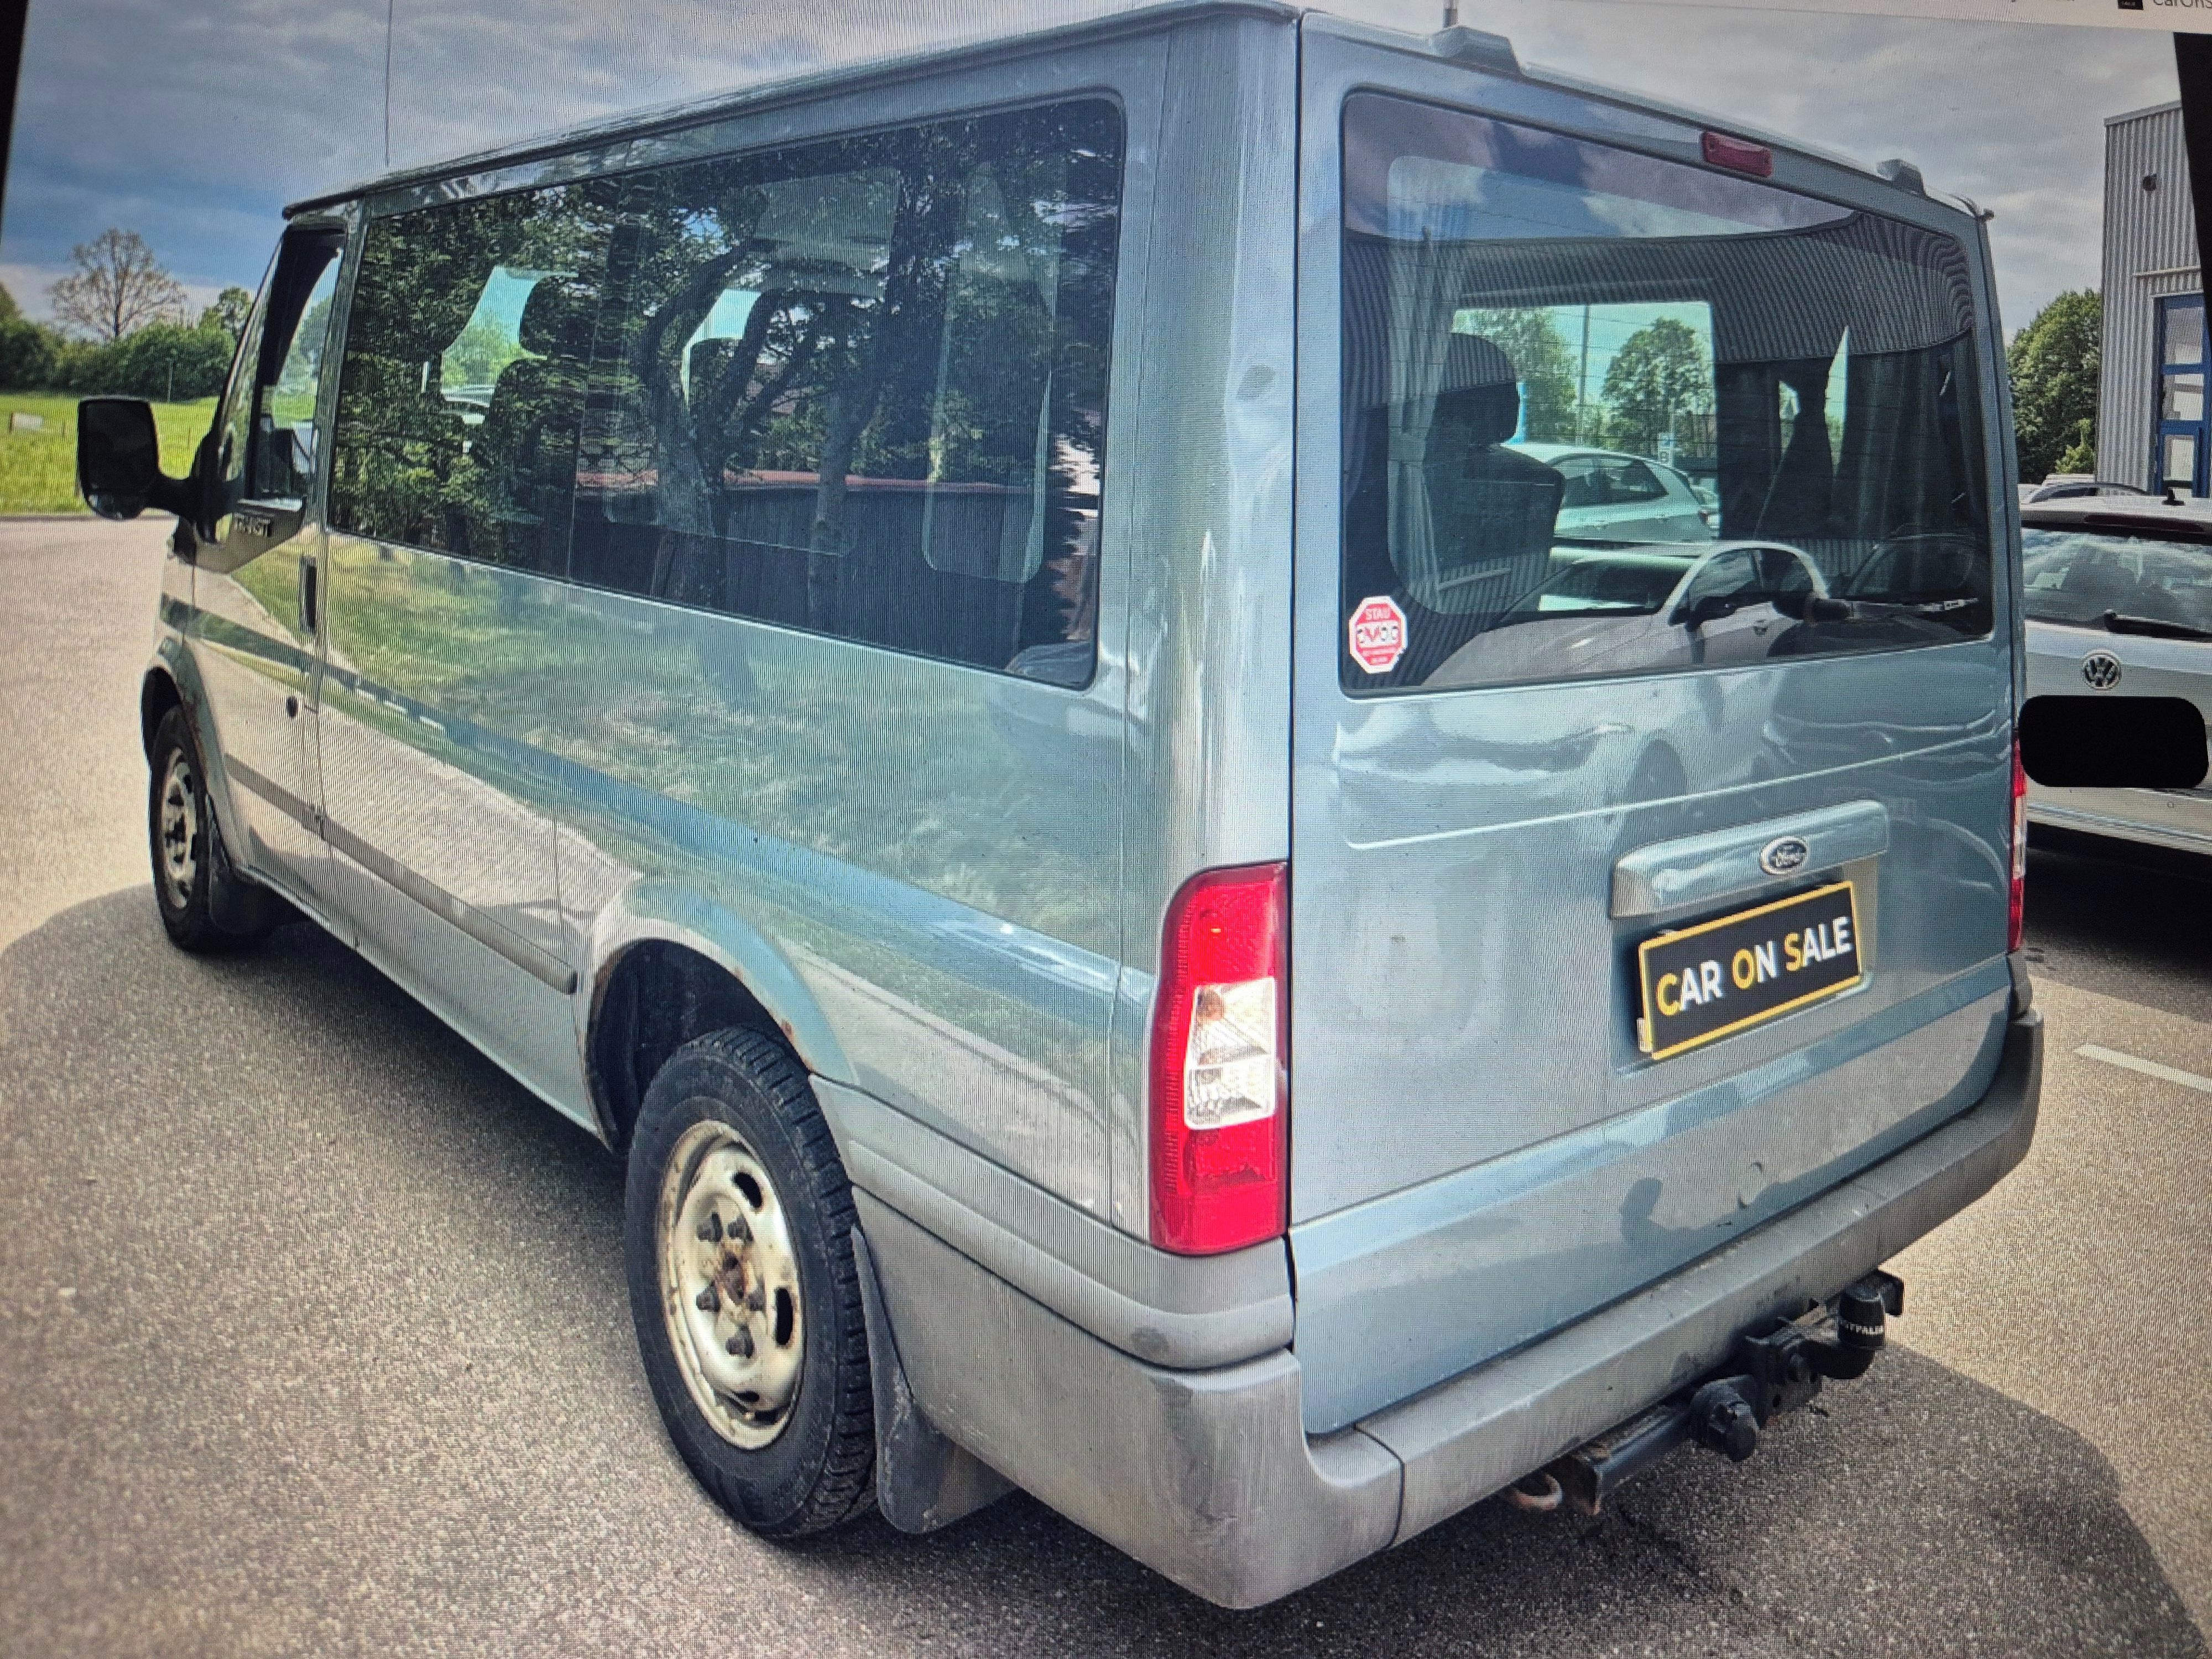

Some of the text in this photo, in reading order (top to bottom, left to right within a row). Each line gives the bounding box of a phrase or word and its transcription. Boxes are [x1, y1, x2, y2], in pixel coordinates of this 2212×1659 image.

[1656, 916, 1853, 1016] CAR ON SALE
